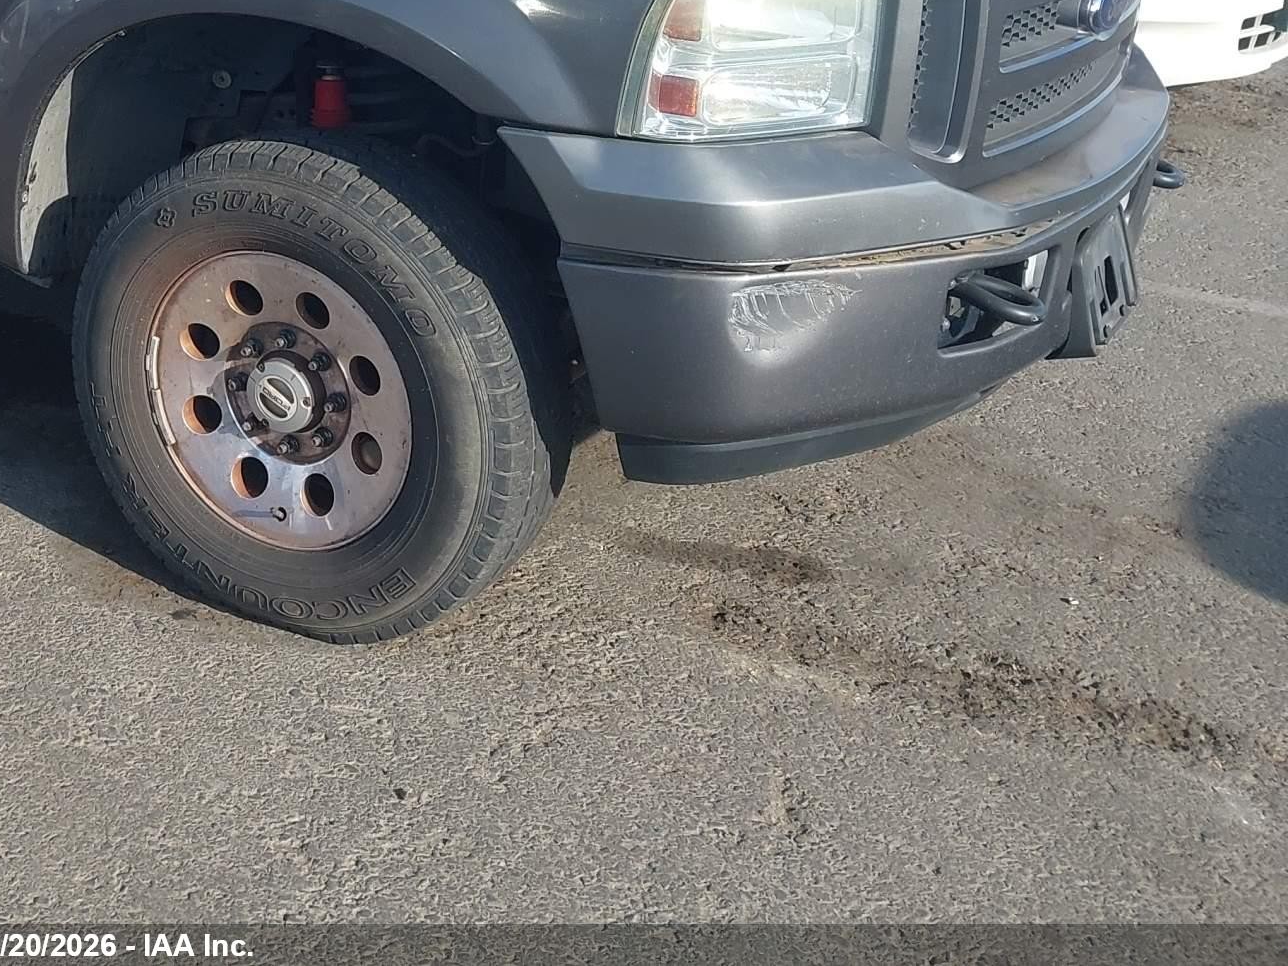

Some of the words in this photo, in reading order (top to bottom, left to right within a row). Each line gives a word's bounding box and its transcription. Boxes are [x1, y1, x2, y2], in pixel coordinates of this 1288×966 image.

[192, 189, 437, 337] SUMITOMO
[262, 386, 291, 412] FORD
[122, 472, 417, 621] ENCOUNTER
